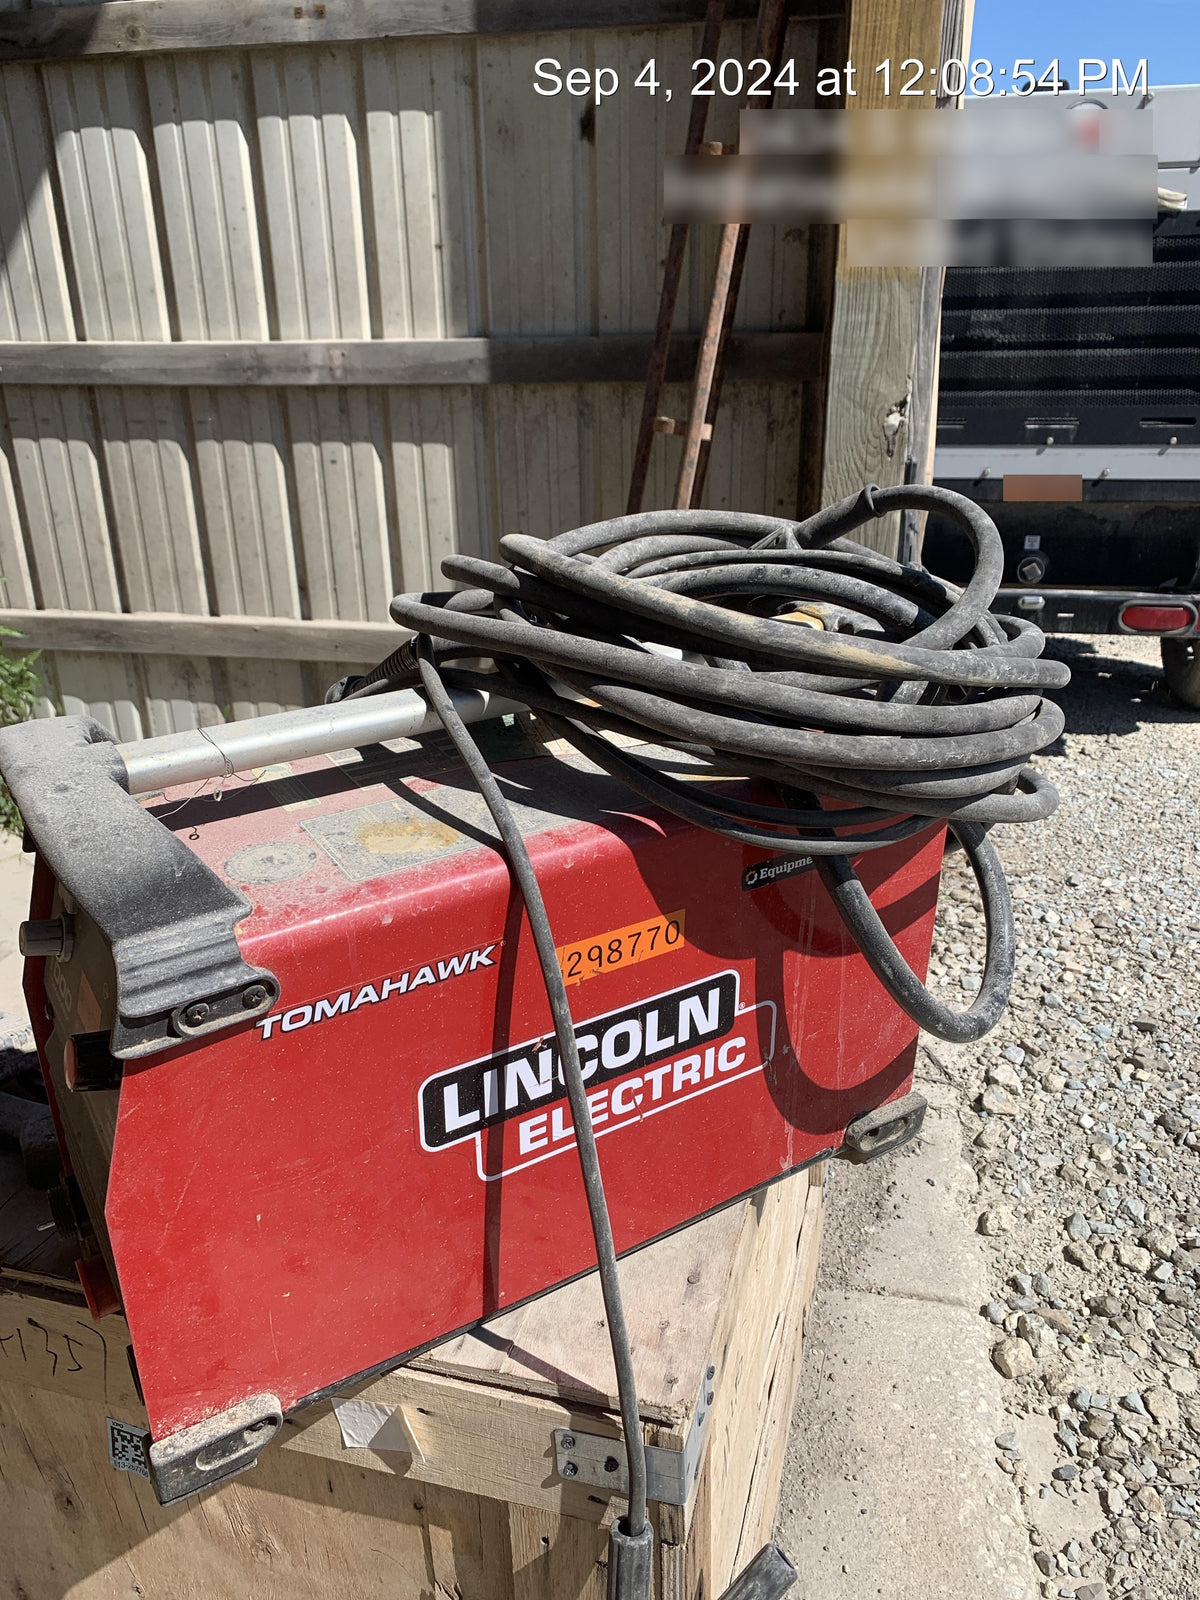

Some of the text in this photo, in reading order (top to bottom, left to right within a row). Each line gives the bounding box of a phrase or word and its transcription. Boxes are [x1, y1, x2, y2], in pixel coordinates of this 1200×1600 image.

[254, 944, 499, 1041] TOMAHAWK
[567, 920, 680, 978] 298770
[443, 987, 721, 1134] LINCOLN
[519, 1036, 746, 1156] ELECTRIC
